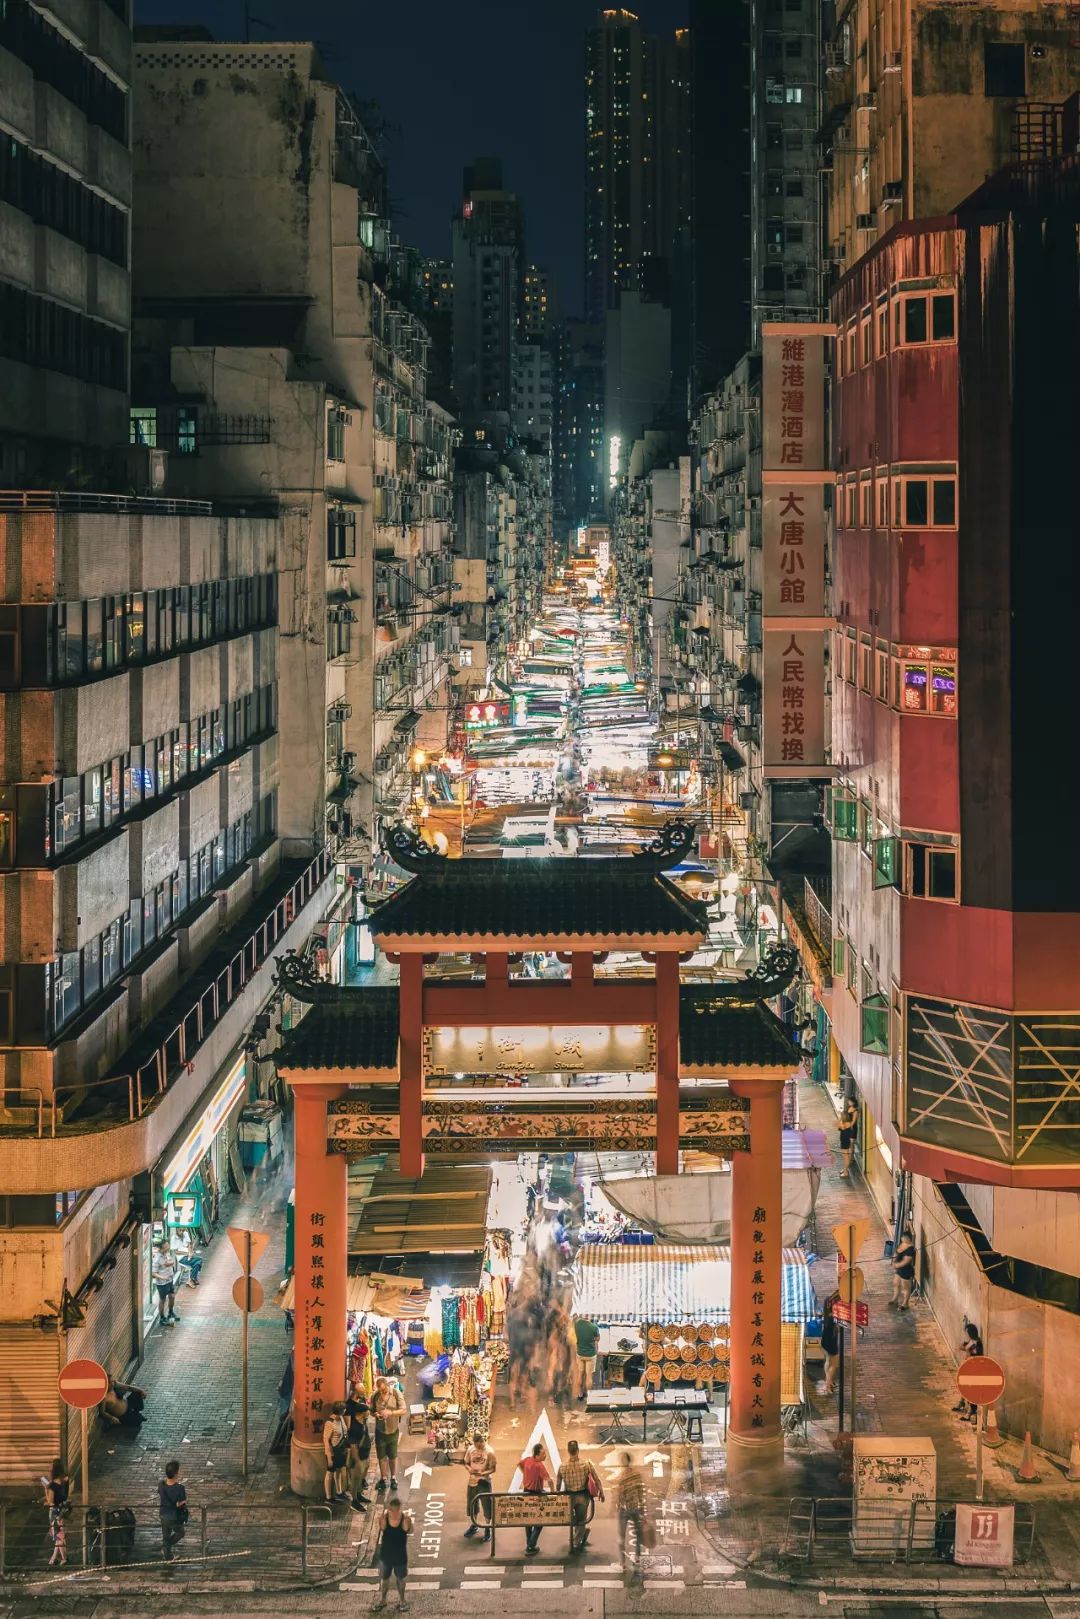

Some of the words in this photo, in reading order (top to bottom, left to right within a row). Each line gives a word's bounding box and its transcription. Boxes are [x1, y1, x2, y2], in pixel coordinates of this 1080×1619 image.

[780, 338, 805, 464] 維港灣酒店
[779, 491, 805, 604] 大唐小館
[781, 633, 805, 761] 人民幣找換
[418, 1530, 441, 1559] LEFT
[423, 1492, 446, 1527] LOOK
